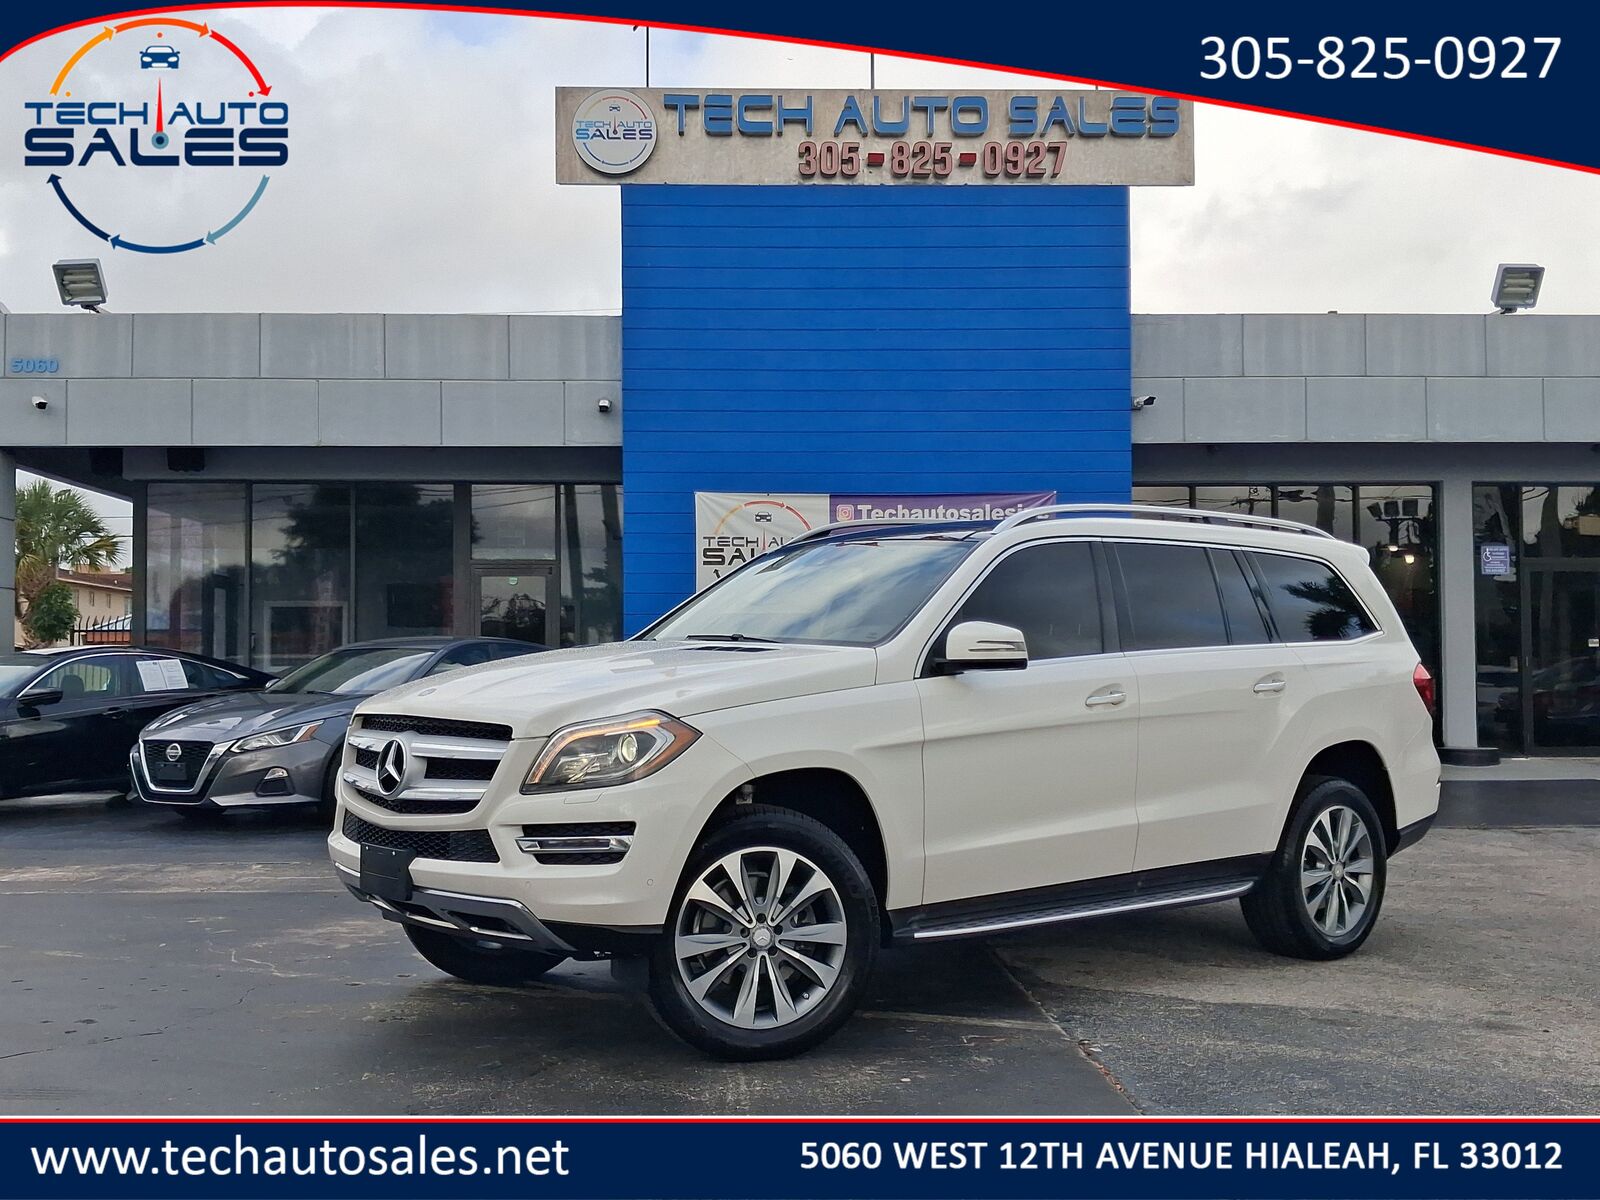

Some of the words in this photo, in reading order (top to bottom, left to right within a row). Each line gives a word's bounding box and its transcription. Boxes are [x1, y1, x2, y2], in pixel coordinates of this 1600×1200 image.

[664, 94, 813, 137] TECH
[834, 95, 989, 138] AUTO
[1009, 95, 1181, 138] SALES
[576, 128, 653, 140] SALES
[798, 141, 1067, 178] 305-825-0927
[12, 359, 59, 373] 5060
[703, 537, 758, 547] TECH
